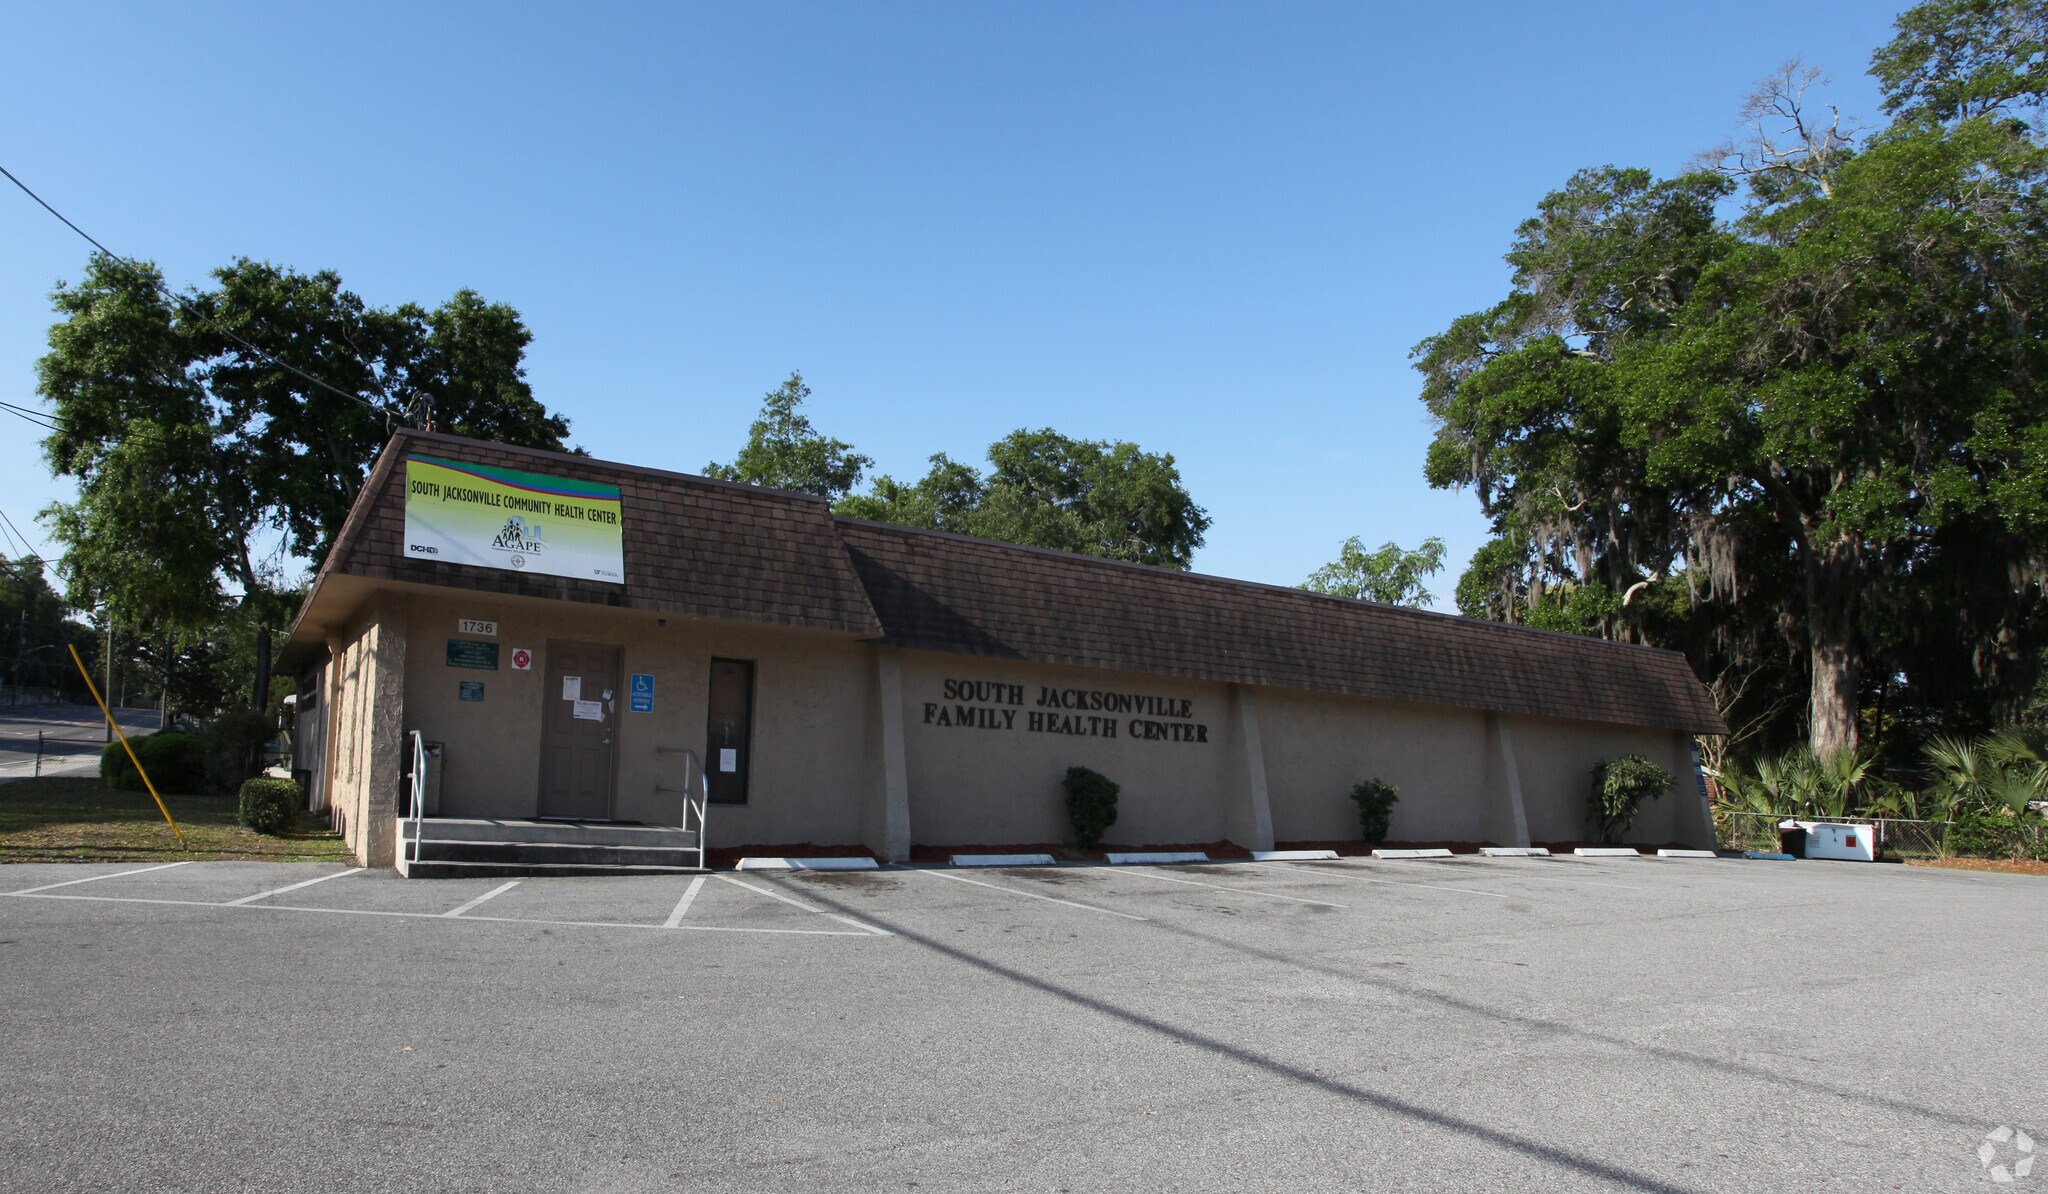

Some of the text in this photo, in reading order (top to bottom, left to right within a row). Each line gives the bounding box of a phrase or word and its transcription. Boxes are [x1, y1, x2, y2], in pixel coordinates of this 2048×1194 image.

[411, 480, 616, 525] SOUTH JACKSONVILLE COMMUNITY HEALTH CENTER
[492, 534, 541, 553] AGAPE
[463, 621, 493, 634] 1736
[944, 678, 1192, 718] SOUTH JACKSONVILLE
[922, 702, 1208, 743] FAMILY HEALTH CENTER
